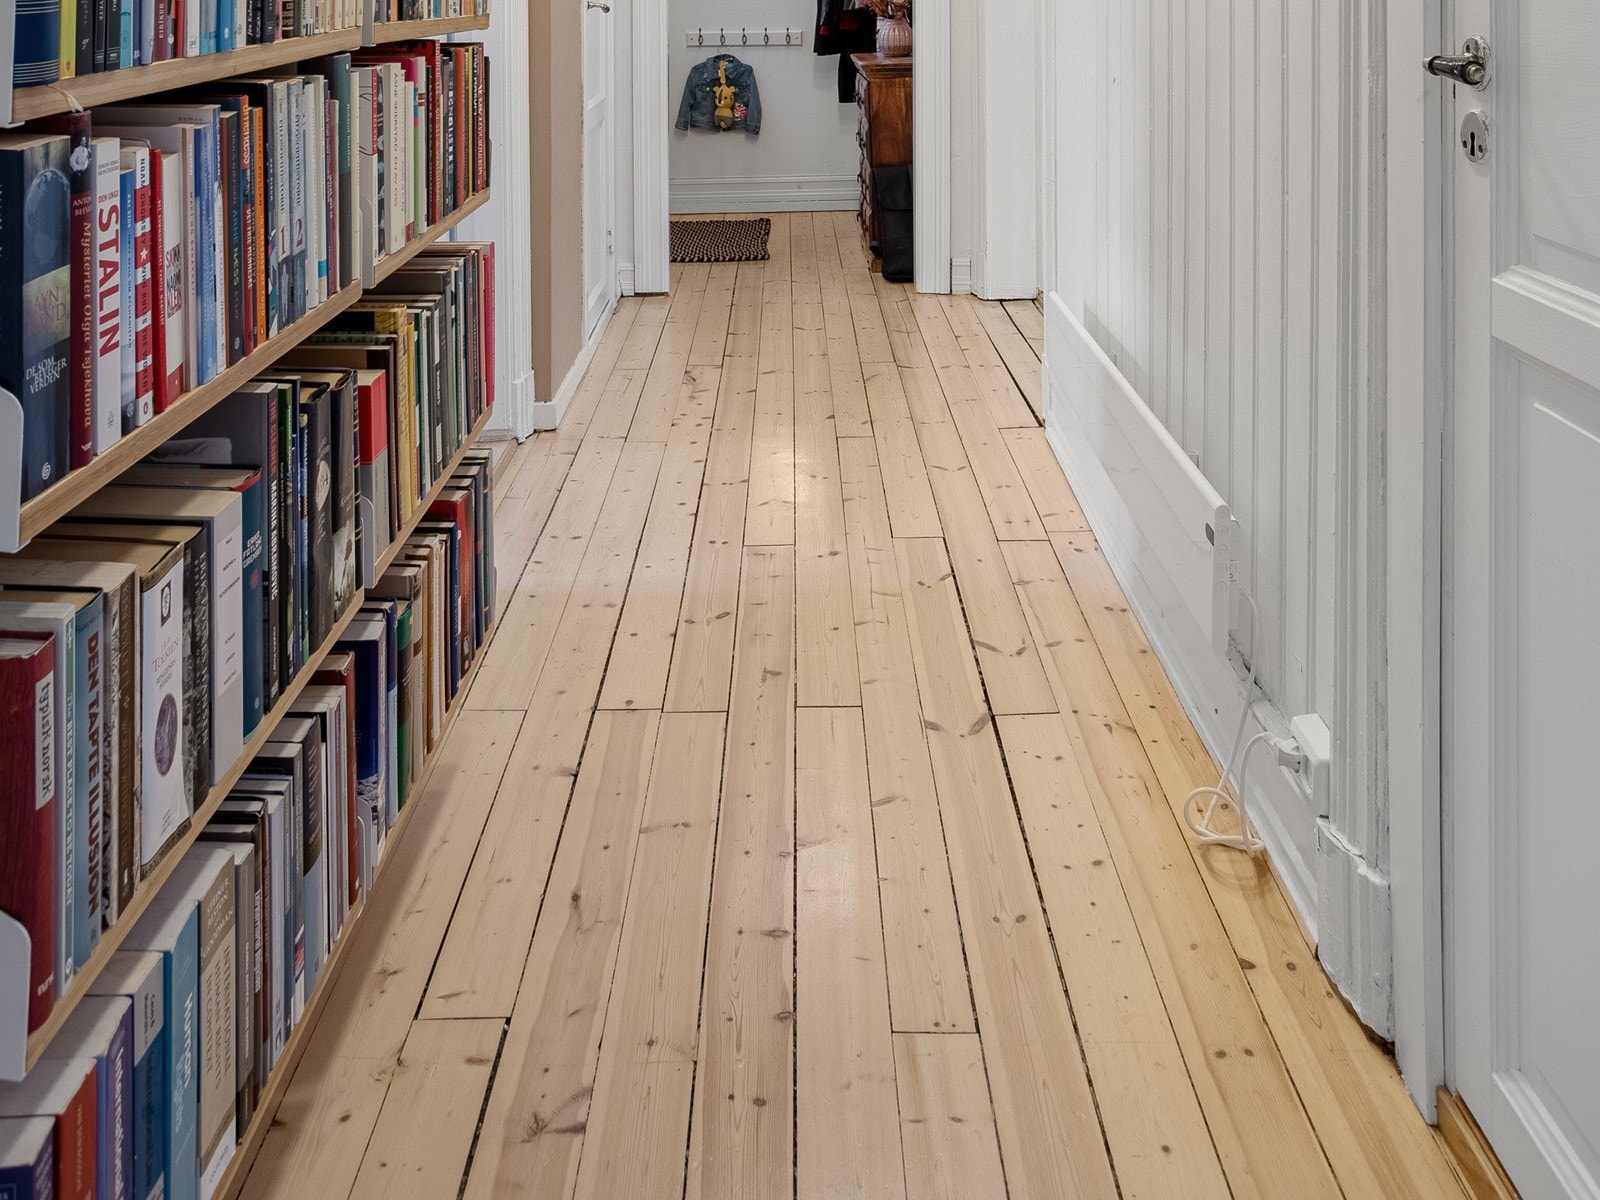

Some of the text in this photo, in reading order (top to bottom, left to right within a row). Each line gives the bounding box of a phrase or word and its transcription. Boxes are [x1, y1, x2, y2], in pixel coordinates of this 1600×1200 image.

[98, 189, 119, 204] DEN UNGE
[98, 203, 120, 358] STALIN
[81, 222, 93, 427] Mysteriet Olga Tsjekhova
[26, 355, 55, 381] DE SOM
[30, 371, 60, 394] VERDEN
[87, 630, 100, 693] DEN
[39, 682, 51, 800] typisk norsk
[88, 691, 100, 783] TAPTE
[66, 811, 73, 832] TO
[66, 834, 73, 855] BE
[206, 974, 213, 996] IN
[184, 991, 193, 1088] Human
